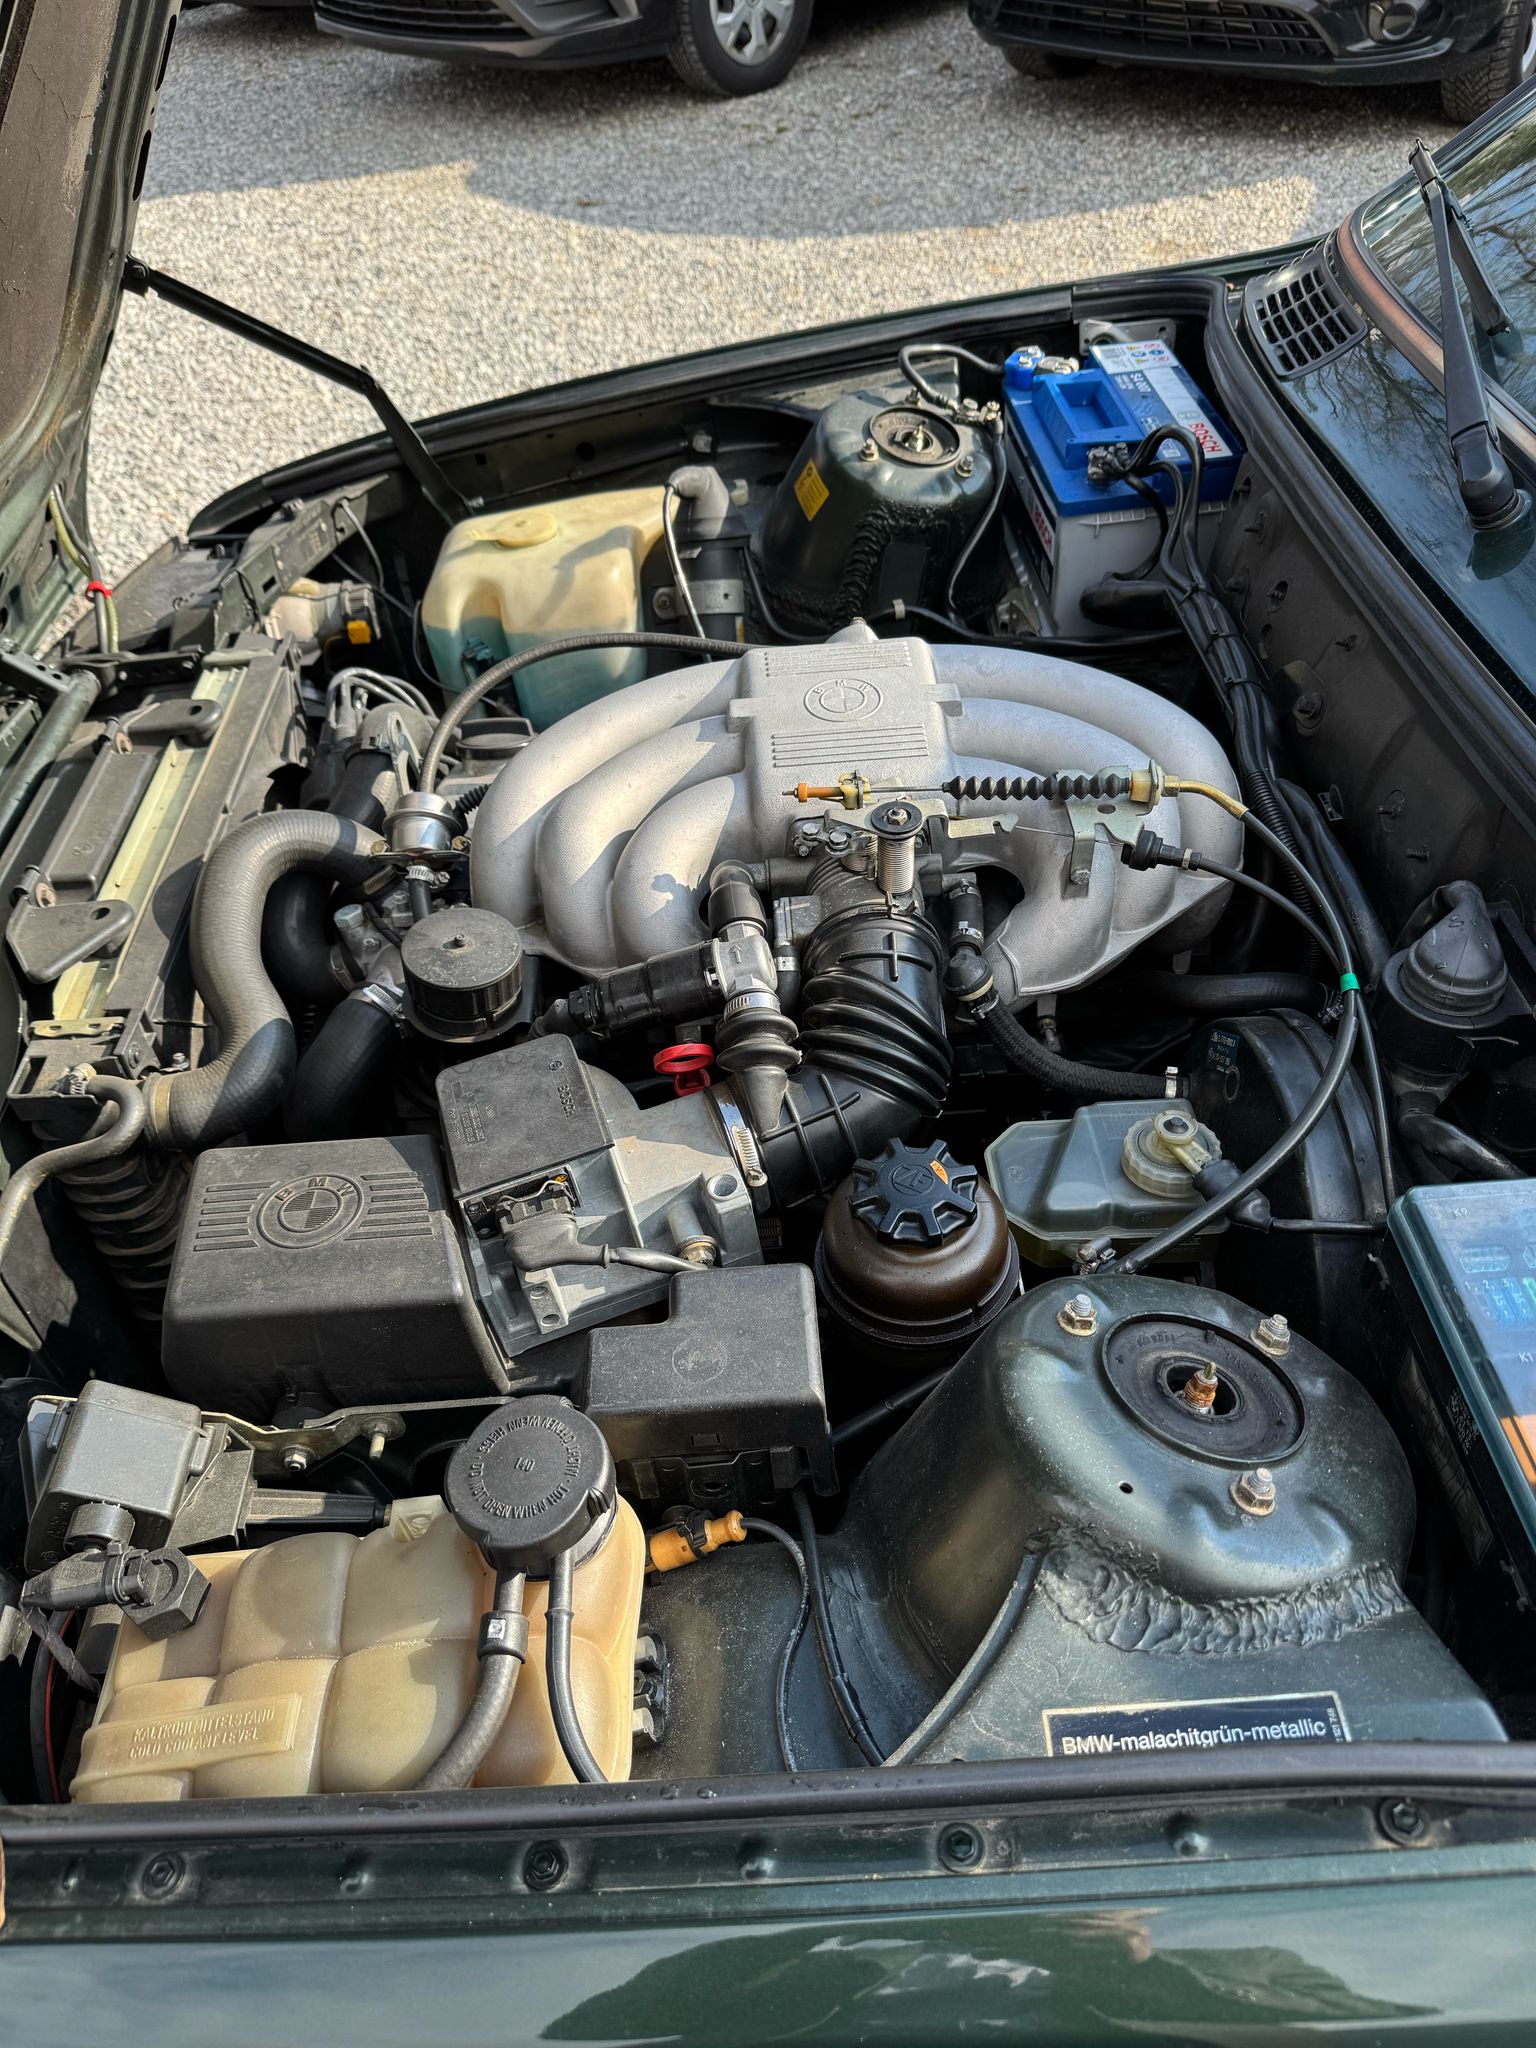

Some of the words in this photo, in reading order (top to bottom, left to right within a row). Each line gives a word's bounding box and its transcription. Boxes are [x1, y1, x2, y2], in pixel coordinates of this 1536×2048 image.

[1188, 423, 1222, 453] BOSCH
[811, 680, 872, 695] BMW
[557, 1085, 577, 1118] BOSCH
[274, 1176, 356, 1202] BMW
[505, 1415, 541, 1432] WENN
[467, 1462, 484, 1479] DO
[467, 1477, 489, 1502] NOT
[546, 1482, 569, 1507] HOT
[483, 1497, 512, 1519] OPEN
[512, 1503, 547, 1520] WHEN
[130, 1741, 162, 1759] COLD
[165, 1733, 219, 1754] COOLANT
[222, 1726, 259, 1745] LEVEL
[1061, 1717, 1328, 1756] BMW-malachitgrün-metallic
